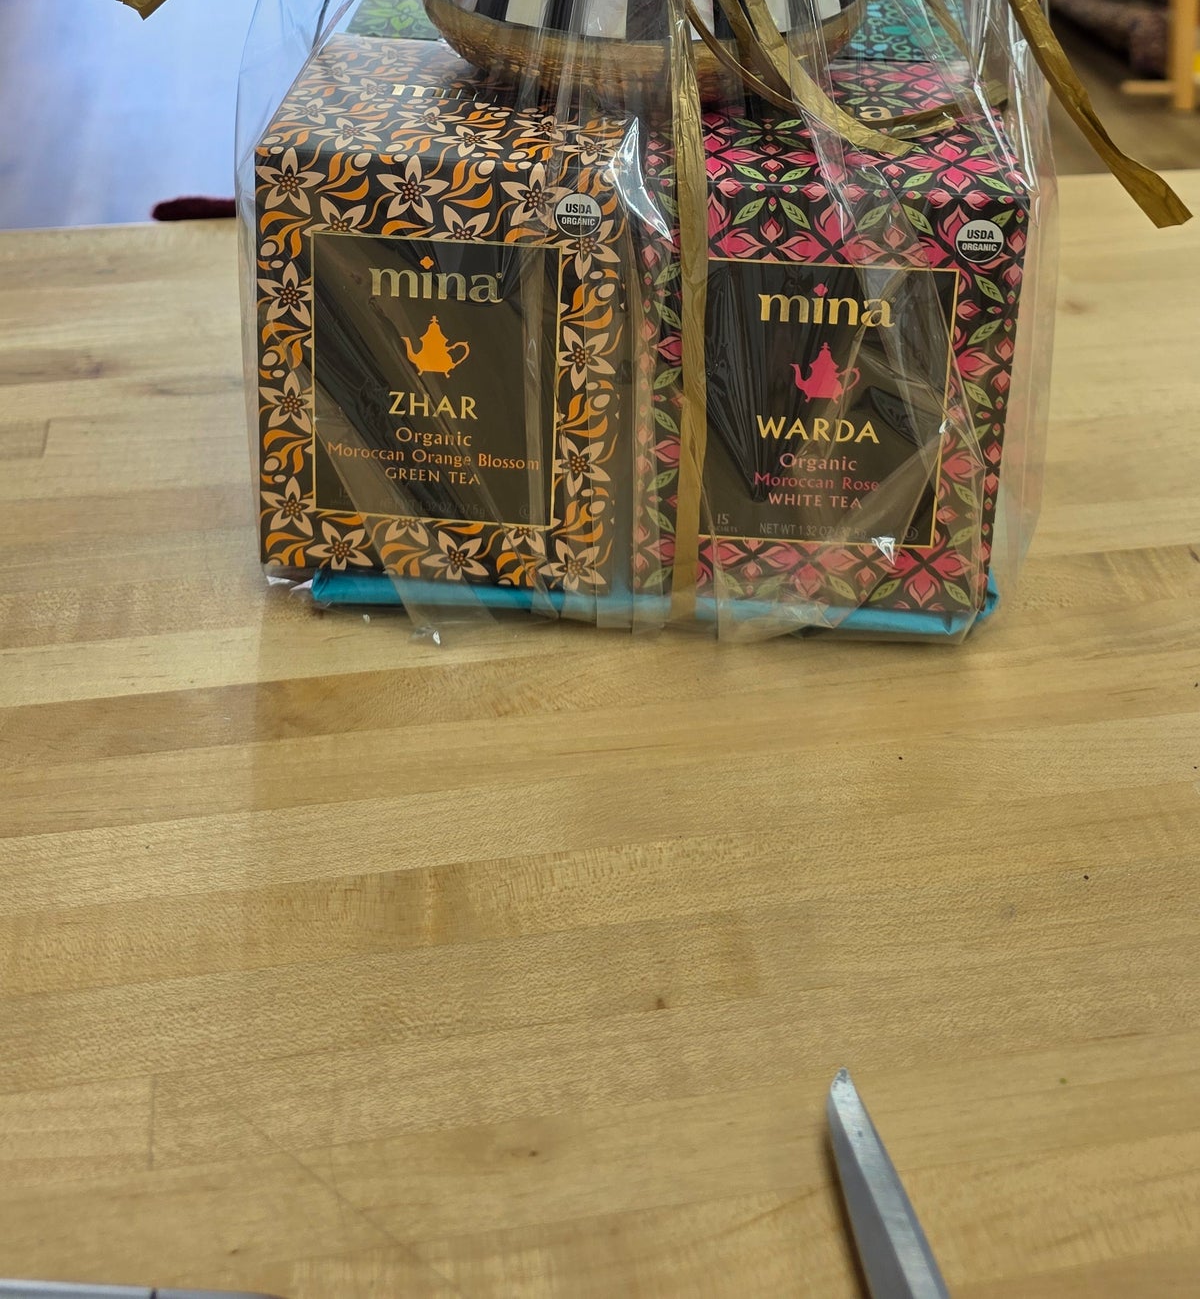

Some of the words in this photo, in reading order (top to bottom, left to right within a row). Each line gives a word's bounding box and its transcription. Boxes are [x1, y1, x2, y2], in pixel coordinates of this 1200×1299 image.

[565, 203, 592, 214] USDA
[561, 217, 596, 226] ORGANIC
[966, 230, 994, 240] USDA
[961, 242, 998, 252] ORGANIC
[368, 256, 503, 304] mina
[758, 283, 895, 328] mina
[388, 391, 479, 420] ZHAR
[395, 427, 473, 447] Organic
[756, 415, 880, 444] WARDA
[327, 442, 404, 461] Moroccan
[411, 449, 472, 468] Orange
[478, 453, 540, 471] Blossom
[780, 452, 857, 472] Organic
[384, 467, 440, 483] GREEN
[448, 471, 481, 486] TEA
[754, 471, 834, 489] Moroccan
[842, 476, 880, 492] Rose
[768, 492, 822, 507] WHITE
[829, 495, 863, 510] TEA
[717, 513, 730, 525] 15
[759, 522, 778, 535] NET
[781, 523, 795, 535] WT
